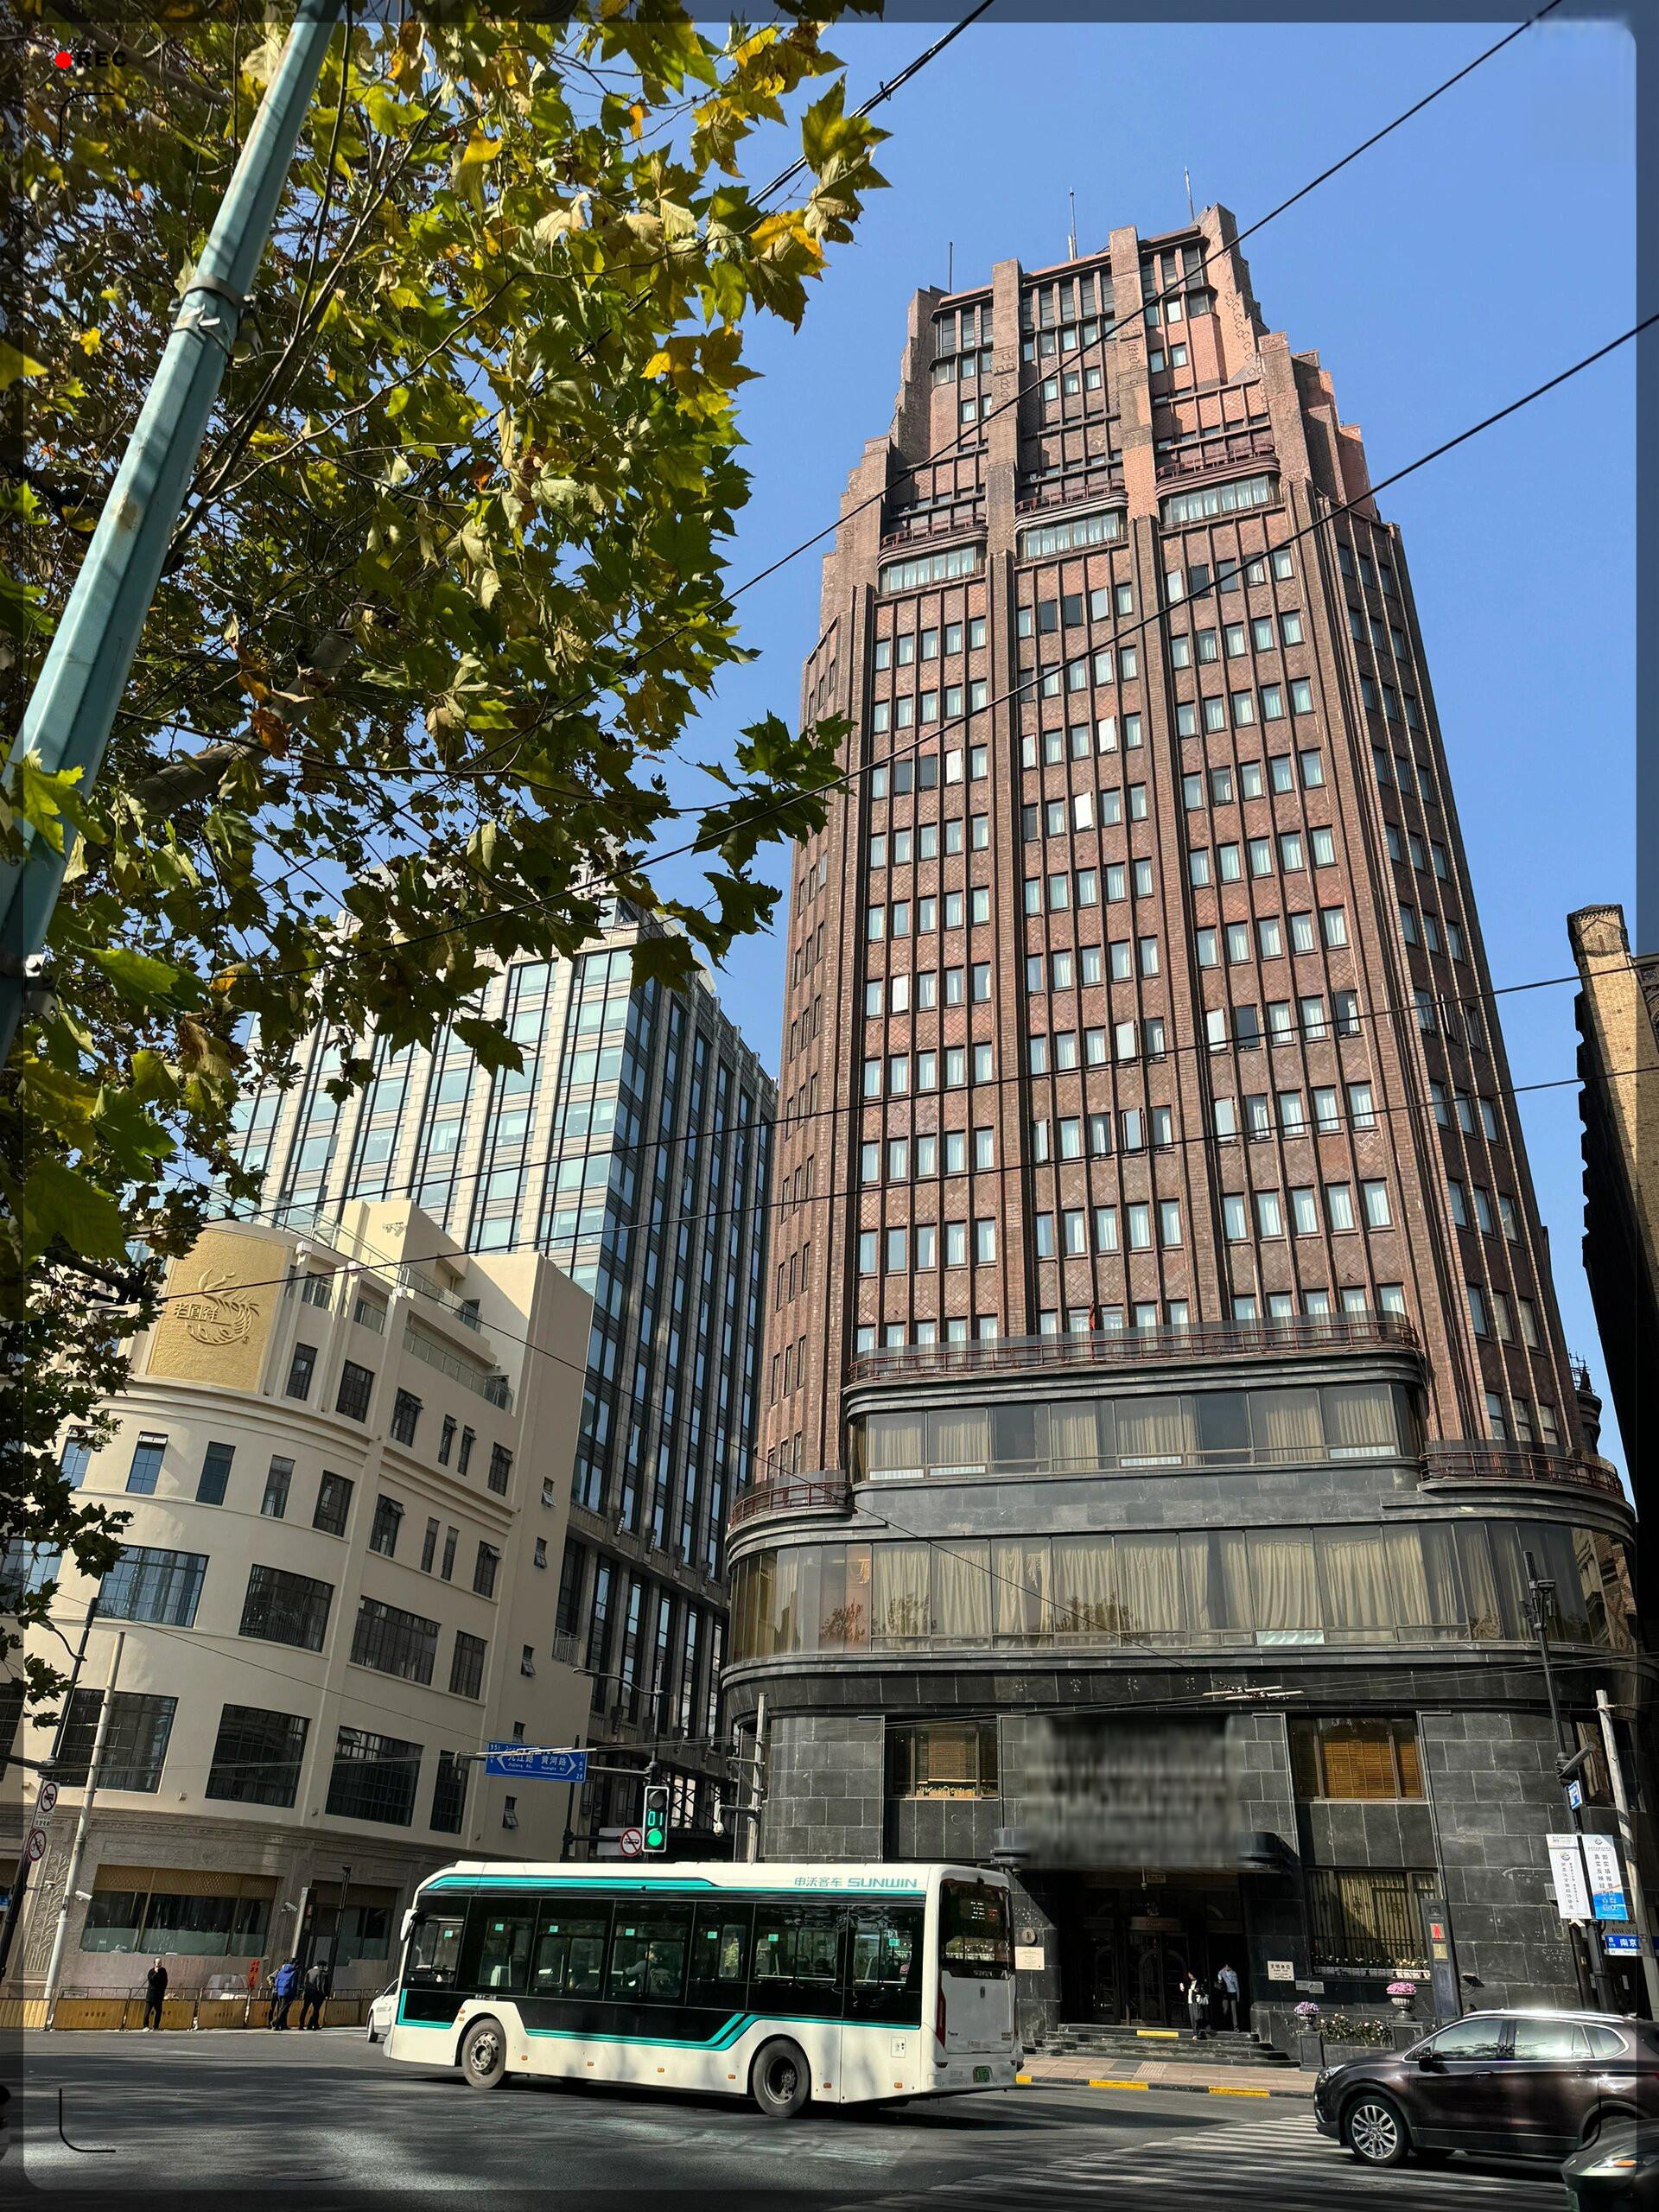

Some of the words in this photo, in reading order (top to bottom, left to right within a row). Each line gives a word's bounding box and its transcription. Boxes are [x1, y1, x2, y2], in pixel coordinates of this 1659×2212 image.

[540, 1755, 567, 1765] 黄河路
[647, 1811, 663, 1826] 01
[794, 1877, 842, 1888] 申沃客车
[847, 1878, 918, 1888] SUNWIN
